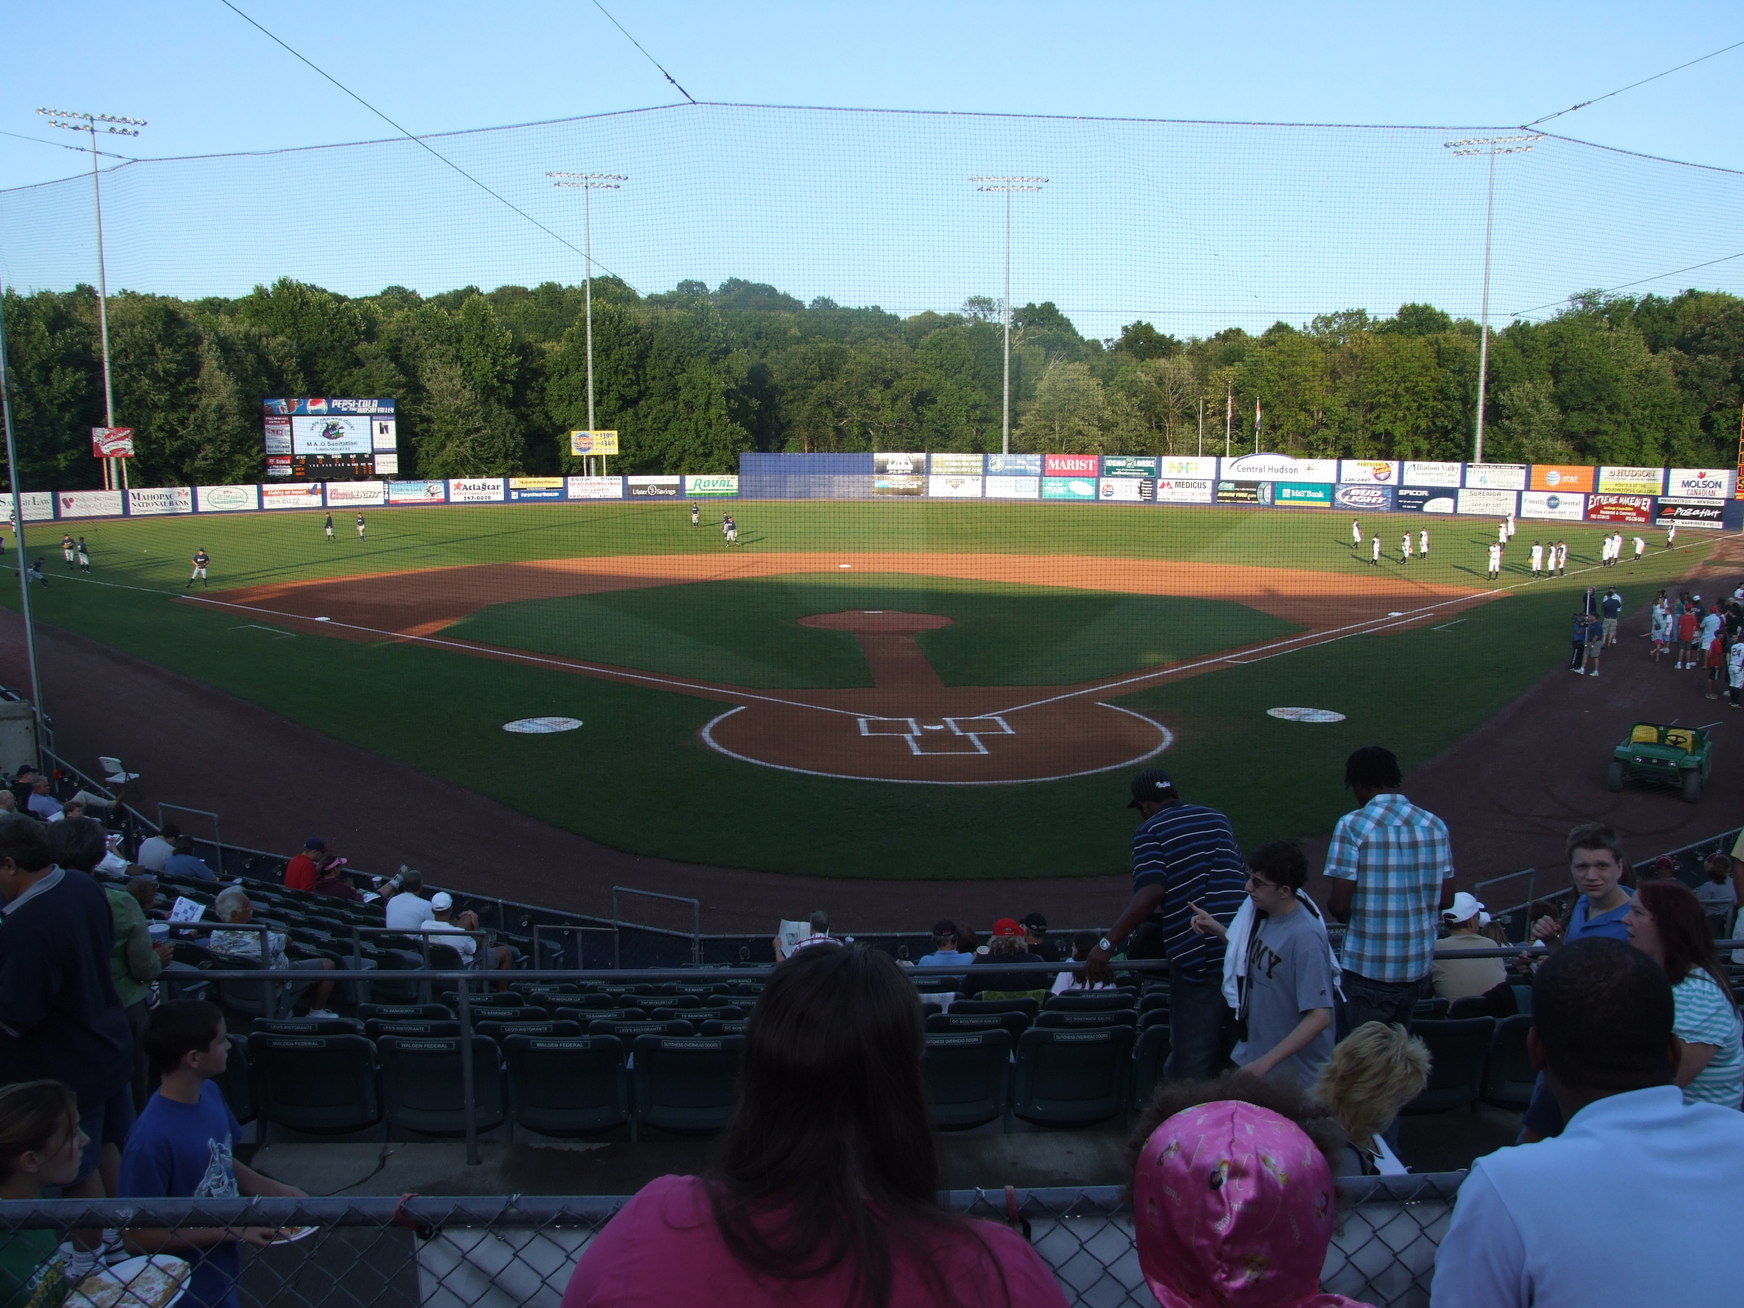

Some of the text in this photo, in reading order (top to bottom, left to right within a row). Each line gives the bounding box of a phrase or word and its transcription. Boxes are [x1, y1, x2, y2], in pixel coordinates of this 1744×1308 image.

[1048, 460, 1096, 470] MARIST
[1236, 464, 1298, 474] Central Hudson
[1174, 481, 1207, 489] MEDICUS
[1681, 480, 1722, 488] MOLSON
[1350, 489, 1382, 497] BUD
[1686, 488, 1716, 496] CANADIAN
[132, 500, 168, 508] NATIONAL
[1344, 496, 1387, 504] LIGHT
[1588, 495, 1650, 512] EXTREME MAKEOVER
[1674, 507, 1700, 516] Pizza
